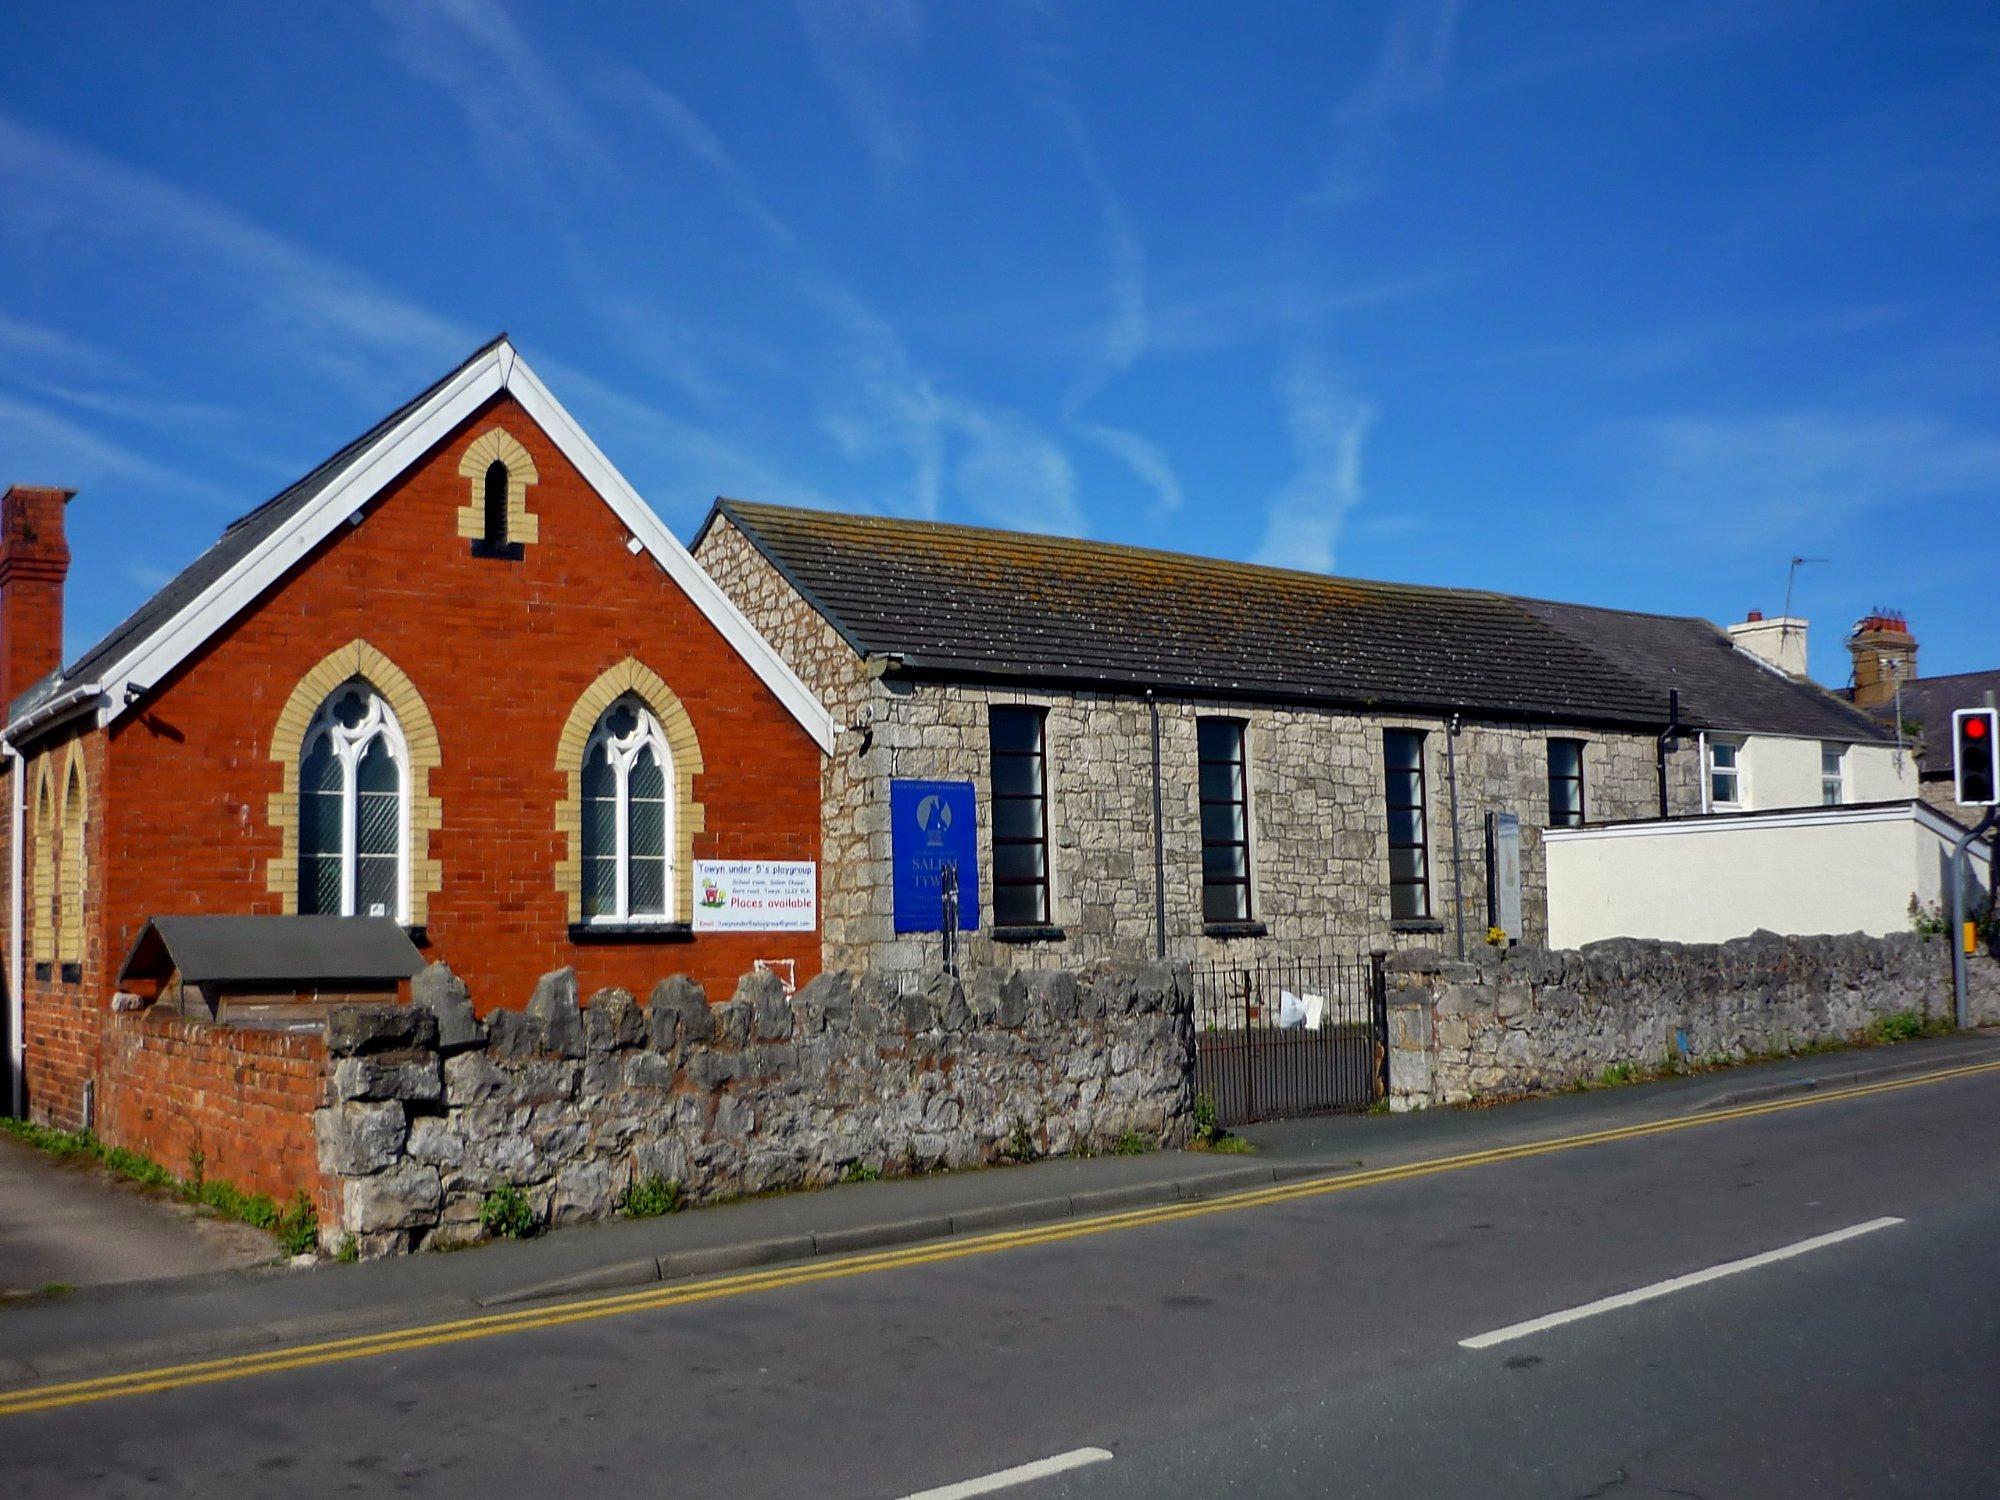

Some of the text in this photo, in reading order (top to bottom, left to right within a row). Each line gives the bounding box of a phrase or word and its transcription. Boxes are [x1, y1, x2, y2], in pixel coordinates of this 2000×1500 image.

[699, 864, 812, 875] Towyn under 5's playgroup
[912, 857, 958, 870] SALEM
[914, 875, 942, 888] TYW
[731, 897, 812, 908] Places available
